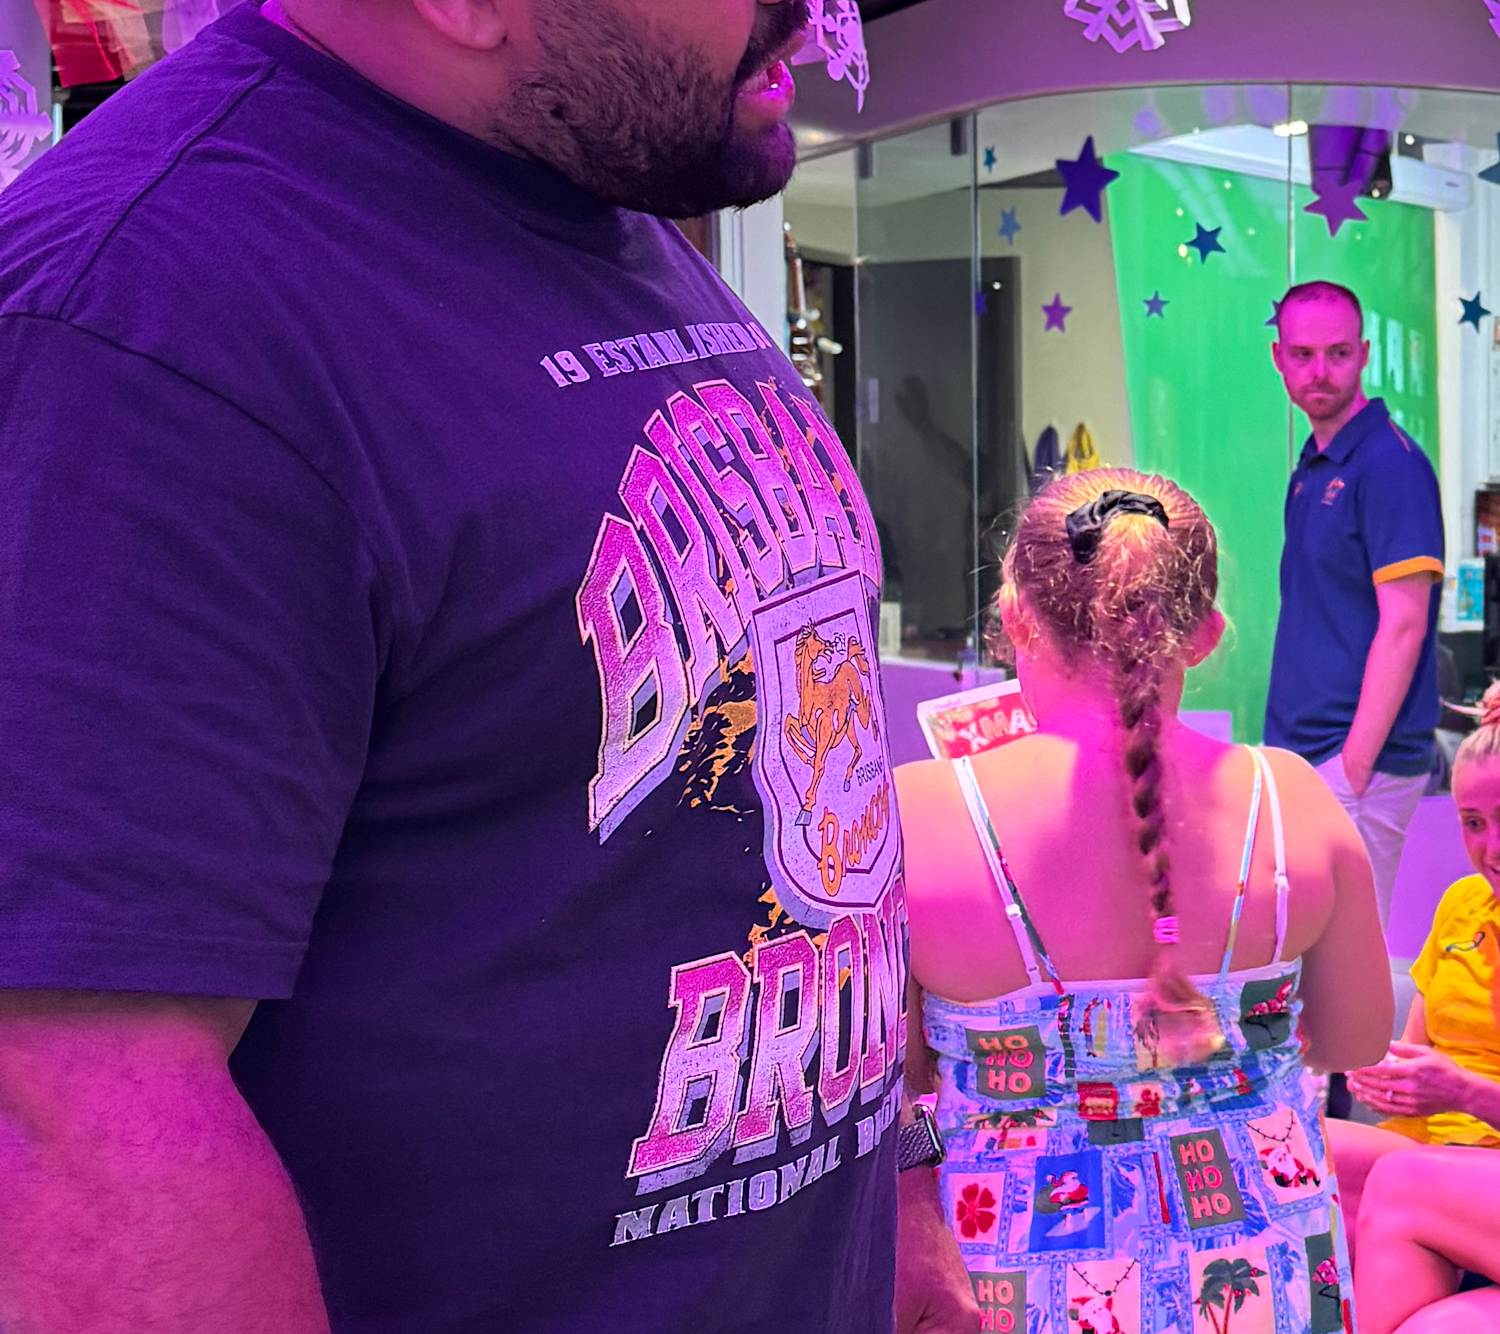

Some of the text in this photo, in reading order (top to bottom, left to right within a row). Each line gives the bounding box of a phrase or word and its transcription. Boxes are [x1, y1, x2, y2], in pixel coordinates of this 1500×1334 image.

[540, 349, 591, 388] 19
[581, 322, 757, 378] ESTABLISHED
[958, 708, 1038, 753] XMA
[977, 1034, 1029, 1051] HO
[985, 1049, 1034, 1069] HO
[987, 1069, 1032, 1094] HO
[1178, 1139, 1215, 1166] HO
[609, 1135, 842, 1248] NATIONAL
[1185, 1165, 1223, 1193] HO
[1190, 1192, 1232, 1219] HO
[977, 1279, 1014, 1305] HO
[979, 1307, 1015, 1333] HO
